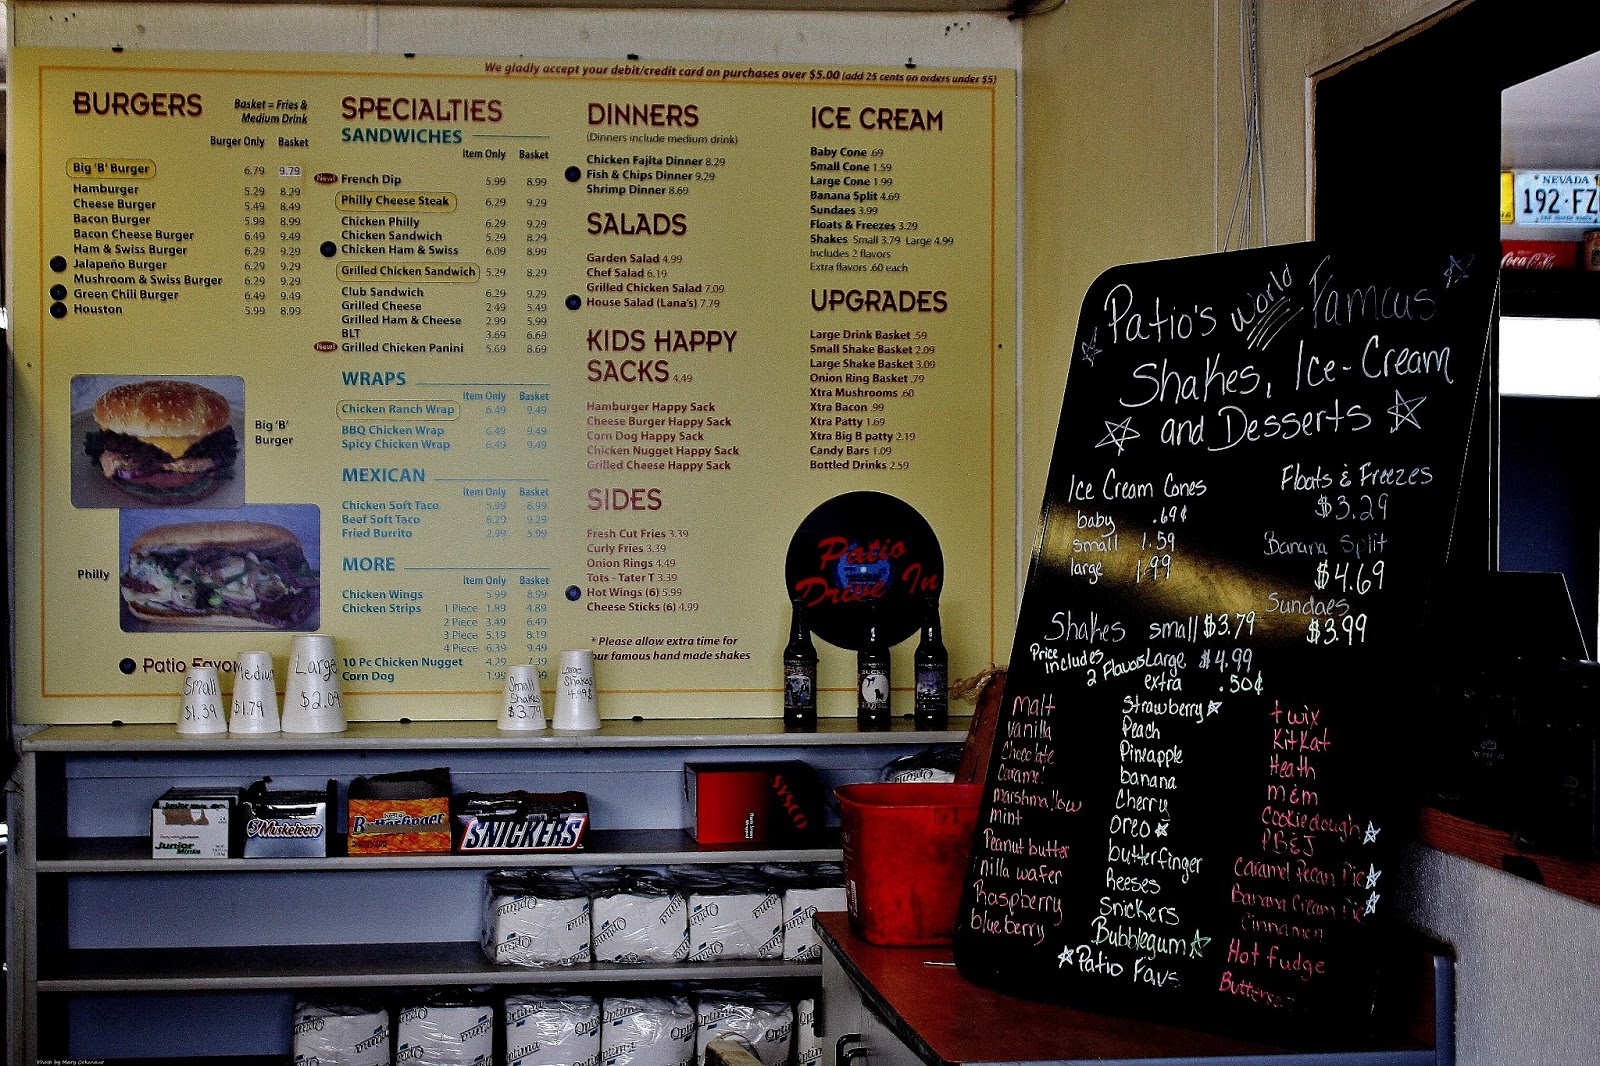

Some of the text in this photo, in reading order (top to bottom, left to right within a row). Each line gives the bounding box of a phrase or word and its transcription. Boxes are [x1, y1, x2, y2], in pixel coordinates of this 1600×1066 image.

[485, 62, 996, 85] We gladly accept your debit/credit card on purchases over $5.00 (add 25 cents on orders under $5)
[73, 92, 203, 117] BURGERS
[341, 96, 502, 122] SPECIALTIES
[588, 103, 700, 126] DINNERS
[812, 106, 943, 131] ICE CREAM
[341, 128, 462, 144] SANDWICHES
[810, 146, 884, 159] Baby Cone .69
[73, 163, 91, 176] Big
[110, 163, 150, 176] Burger
[244, 166, 266, 176] 6.79
[279, 166, 301, 176] 9.79
[586, 169, 715, 183] Fish & Chips Dinner 9.29
[1542, 175, 1589, 184] NEVADA
[587, 213, 687, 236] SALADS
[810, 262, 908, 274] Extra flavors .60 each
[586, 297, 620, 308] House
[624, 297, 653, 308] Salad
[700, 299, 720, 308] 7.79
[812, 289, 948, 313] UPGRADES
[1308, 256, 1436, 328] Famous
[74, 303, 123, 315] Houston
[342, 328, 361, 338] BLT
[587, 330, 737, 353] KIDS HAPPY
[342, 342, 464, 355] Grilled Chicken Panini
[342, 371, 406, 386] WRAPS
[587, 360, 693, 383] SACKS 4.49
[1119, 353, 1272, 407] Shakes,
[342, 404, 455, 418] Chicken Ranch Wrap
[1160, 399, 1371, 451] and Desserts
[342, 468, 426, 483] MEXICAN
[810, 459, 909, 470] Bottled Drinks 2.59
[1068, 469, 1207, 501] Ice Cream Cones
[1282, 463, 1433, 490] Floats & Freezes
[587, 488, 662, 511] SIDES
[1315, 494, 1389, 522] $3.29
[1077, 511, 1116, 536] baby
[817, 536, 906, 571] Patio
[1072, 532, 1175, 553] small 1.59
[1264, 530, 1387, 556] Banana Split
[77, 568, 109, 583] Philly
[342, 557, 396, 572] MORE
[587, 558, 676, 571] Onion Rings 4.49
[1069, 555, 1171, 584] large 1.99
[794, 562, 939, 608] Drive In
[1315, 560, 1385, 595] $4.69
[1267, 593, 1350, 616] Sundaes
[1044, 611, 1255, 643] Shakes small $3.79
[1307, 614, 1367, 645] $3.99
[143, 658, 186, 673] Patio
[295, 653, 338, 682] Large
[1146, 649, 1252, 670] Large $4.99
[184, 677, 217, 696] Small
[342, 671, 395, 685] Corn Dog
[509, 676, 535, 692] Small
[563, 675, 593, 687] Shakes
[1145, 675, 1182, 692] extra
[234, 700, 265, 718] $1.79
[299, 690, 342, 710] $2.09
[510, 693, 540, 704] Shakes
[184, 706, 217, 721] $1.39
[507, 705, 541, 719] $3.79
[1120, 767, 1177, 791] banana
[1269, 756, 1316, 780] Heath
[771, 774, 808, 829] SYSCO
[1115, 792, 1170, 820] Cherry
[259, 820, 322, 838] Musketeers
[990, 809, 1022, 826] mint
[464, 818, 581, 849] SNICKERS
[155, 841, 195, 850] Junior
[1108, 840, 1203, 884] butterfinger
[1106, 869, 1161, 895] Reeses
[1099, 899, 1179, 926] Snickers
[1091, 917, 1187, 962] Bubblegum
[1227, 938, 1262, 966] Hot
[1077, 950, 1181, 988] Patio Favs
